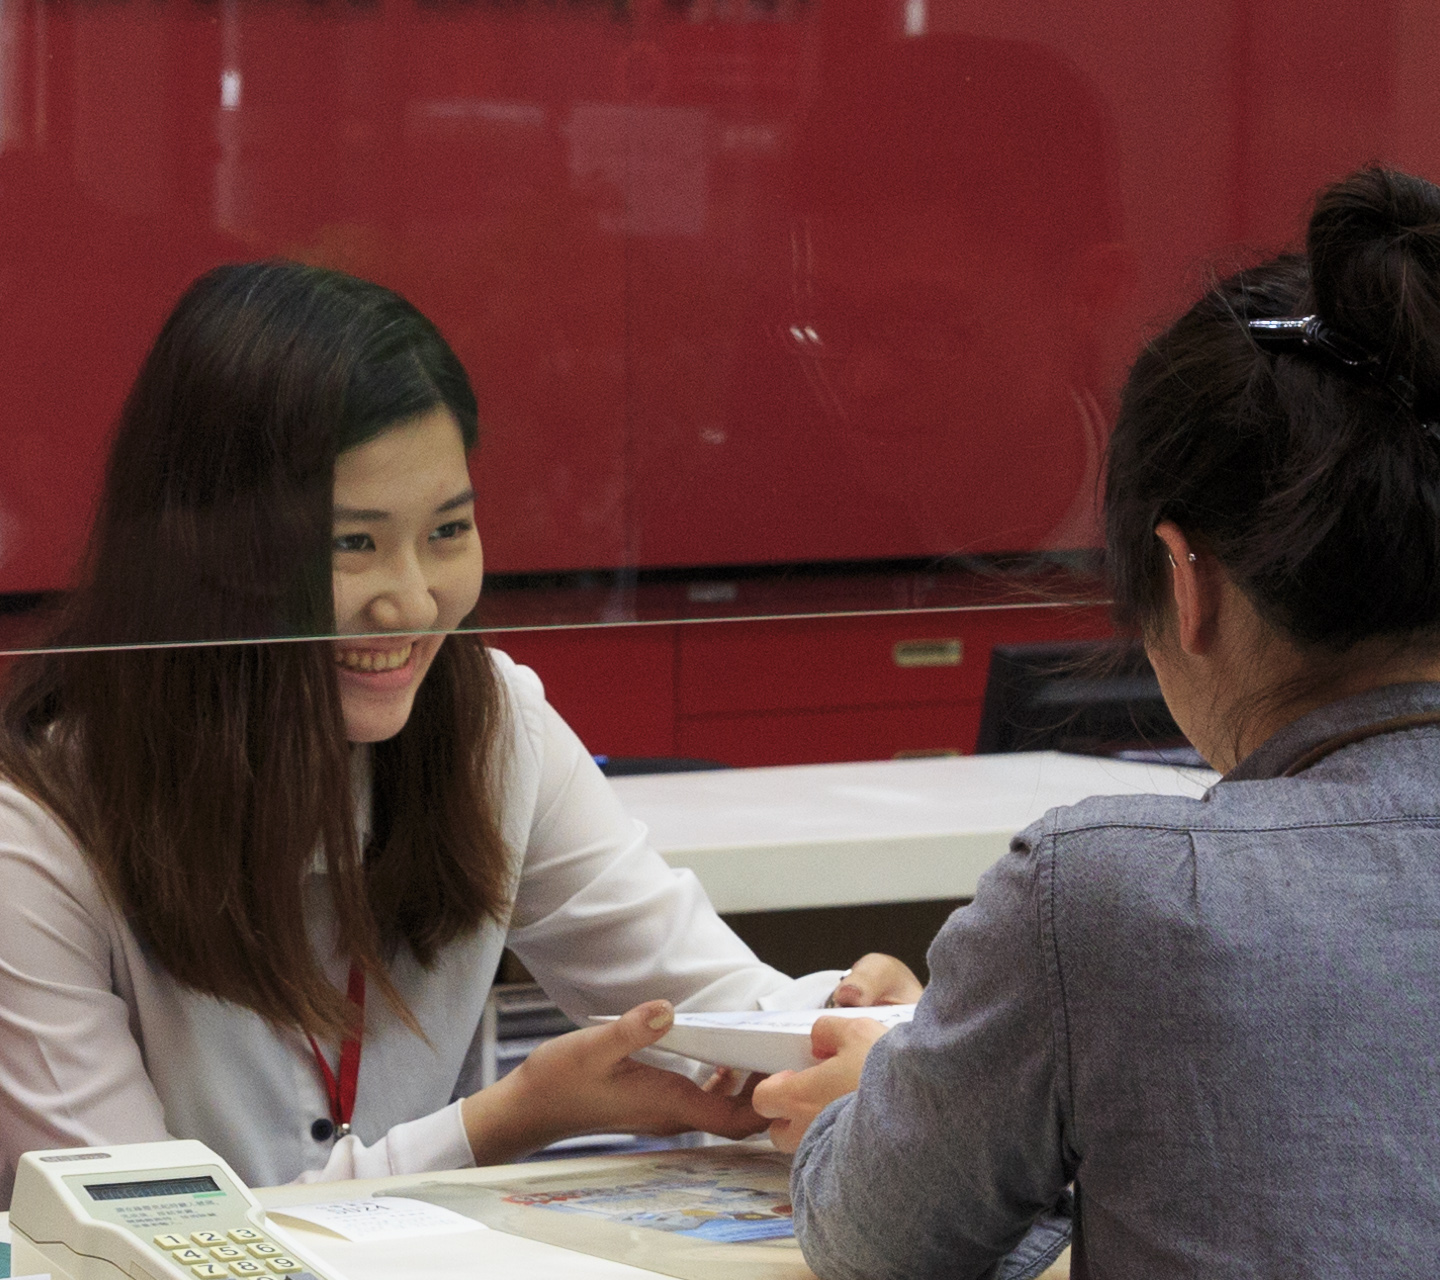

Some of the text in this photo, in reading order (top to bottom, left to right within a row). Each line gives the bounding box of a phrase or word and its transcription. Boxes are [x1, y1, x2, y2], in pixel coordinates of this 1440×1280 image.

[165, 1228, 256, 1244] 1 2 3
[183, 1243, 275, 1258] 4 5 6
[198, 1258, 294, 1274] 7 8 9
